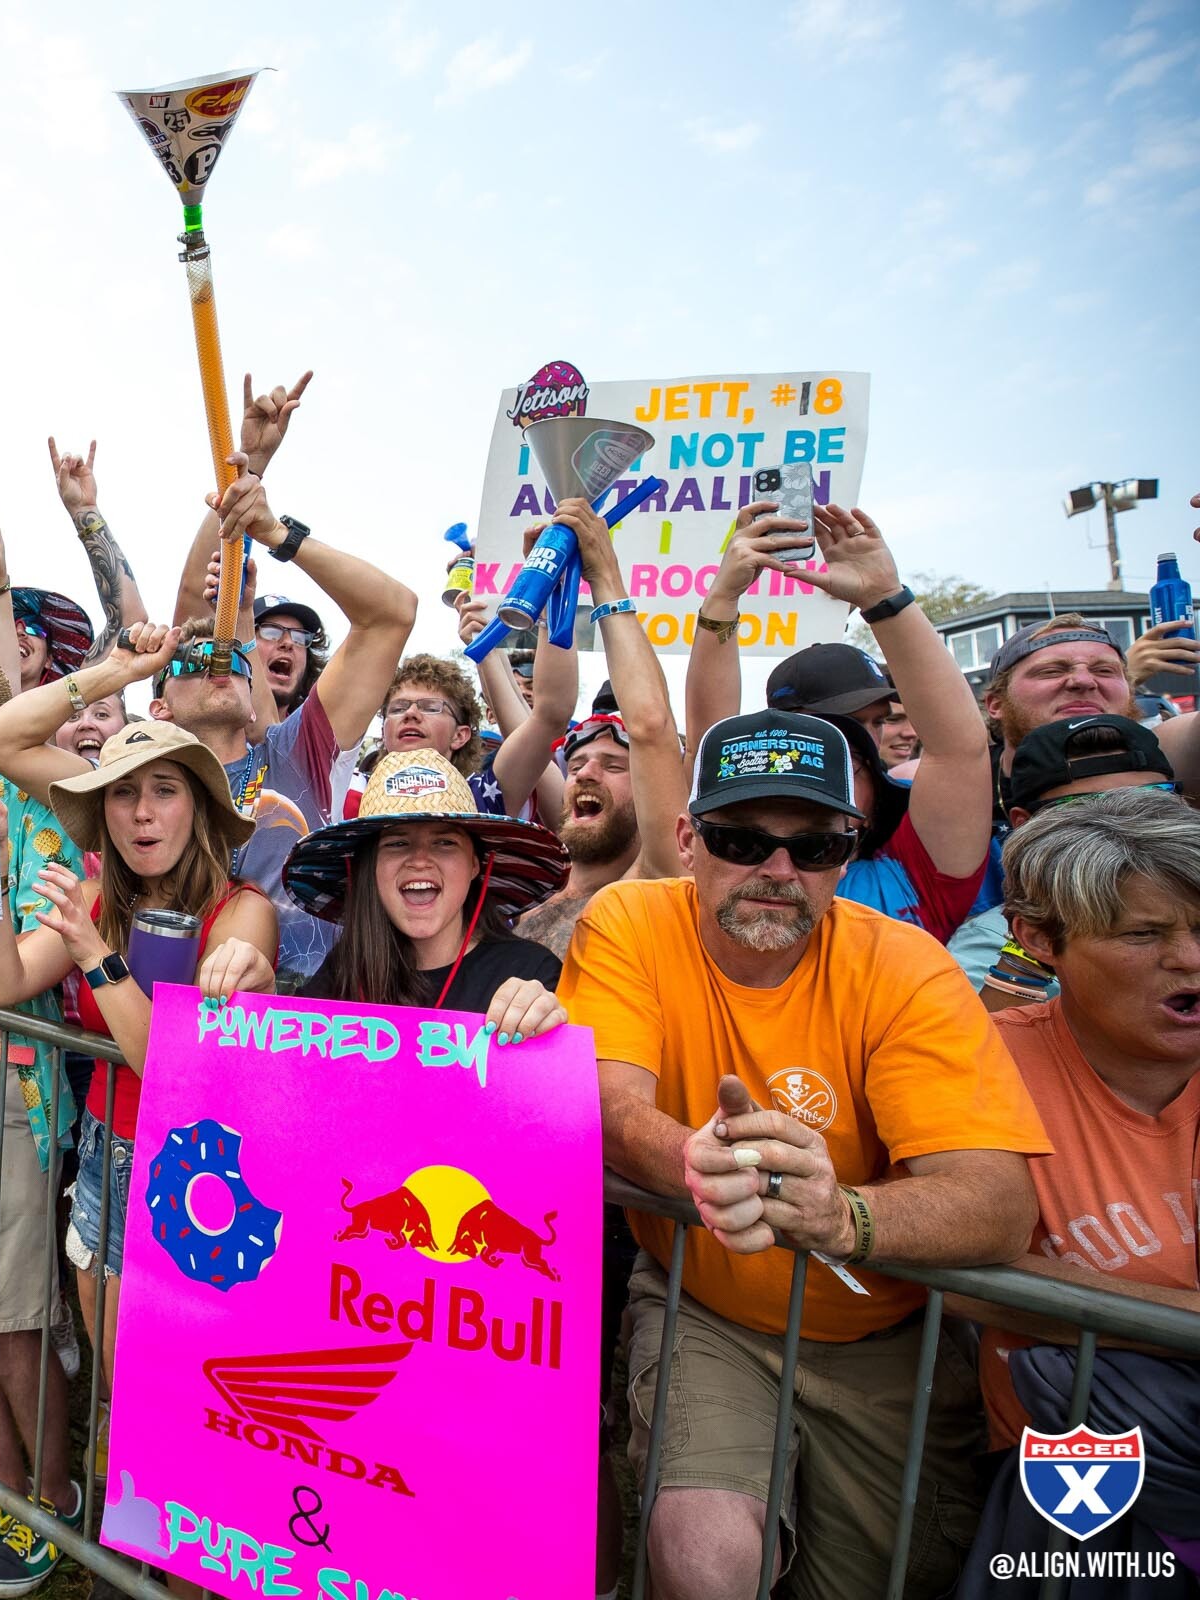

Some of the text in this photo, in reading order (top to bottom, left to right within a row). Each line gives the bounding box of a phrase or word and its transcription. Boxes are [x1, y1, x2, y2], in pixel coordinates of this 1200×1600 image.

[165, 111, 189, 131] 25
[195, 147, 217, 181] P
[507, 380, 589, 419] Jettson
[635, 378, 844, 425] JETT, #18
[670, 432, 765, 470] NOT
[783, 427, 847, 465] BE
[659, 520, 673, 555] I
[722, 738, 825, 756] CORNERSTONE
[801, 754, 825, 769] AG
[197, 1001, 492, 1088] POWERED BY
[855, 1201, 870, 1220] JULY
[329, 1263, 563, 1370] Red Bull
[203, 1408, 416, 1498] HONDA
[288, 1485, 332, 1552] &
[164, 1500, 302, 1596] PURE
